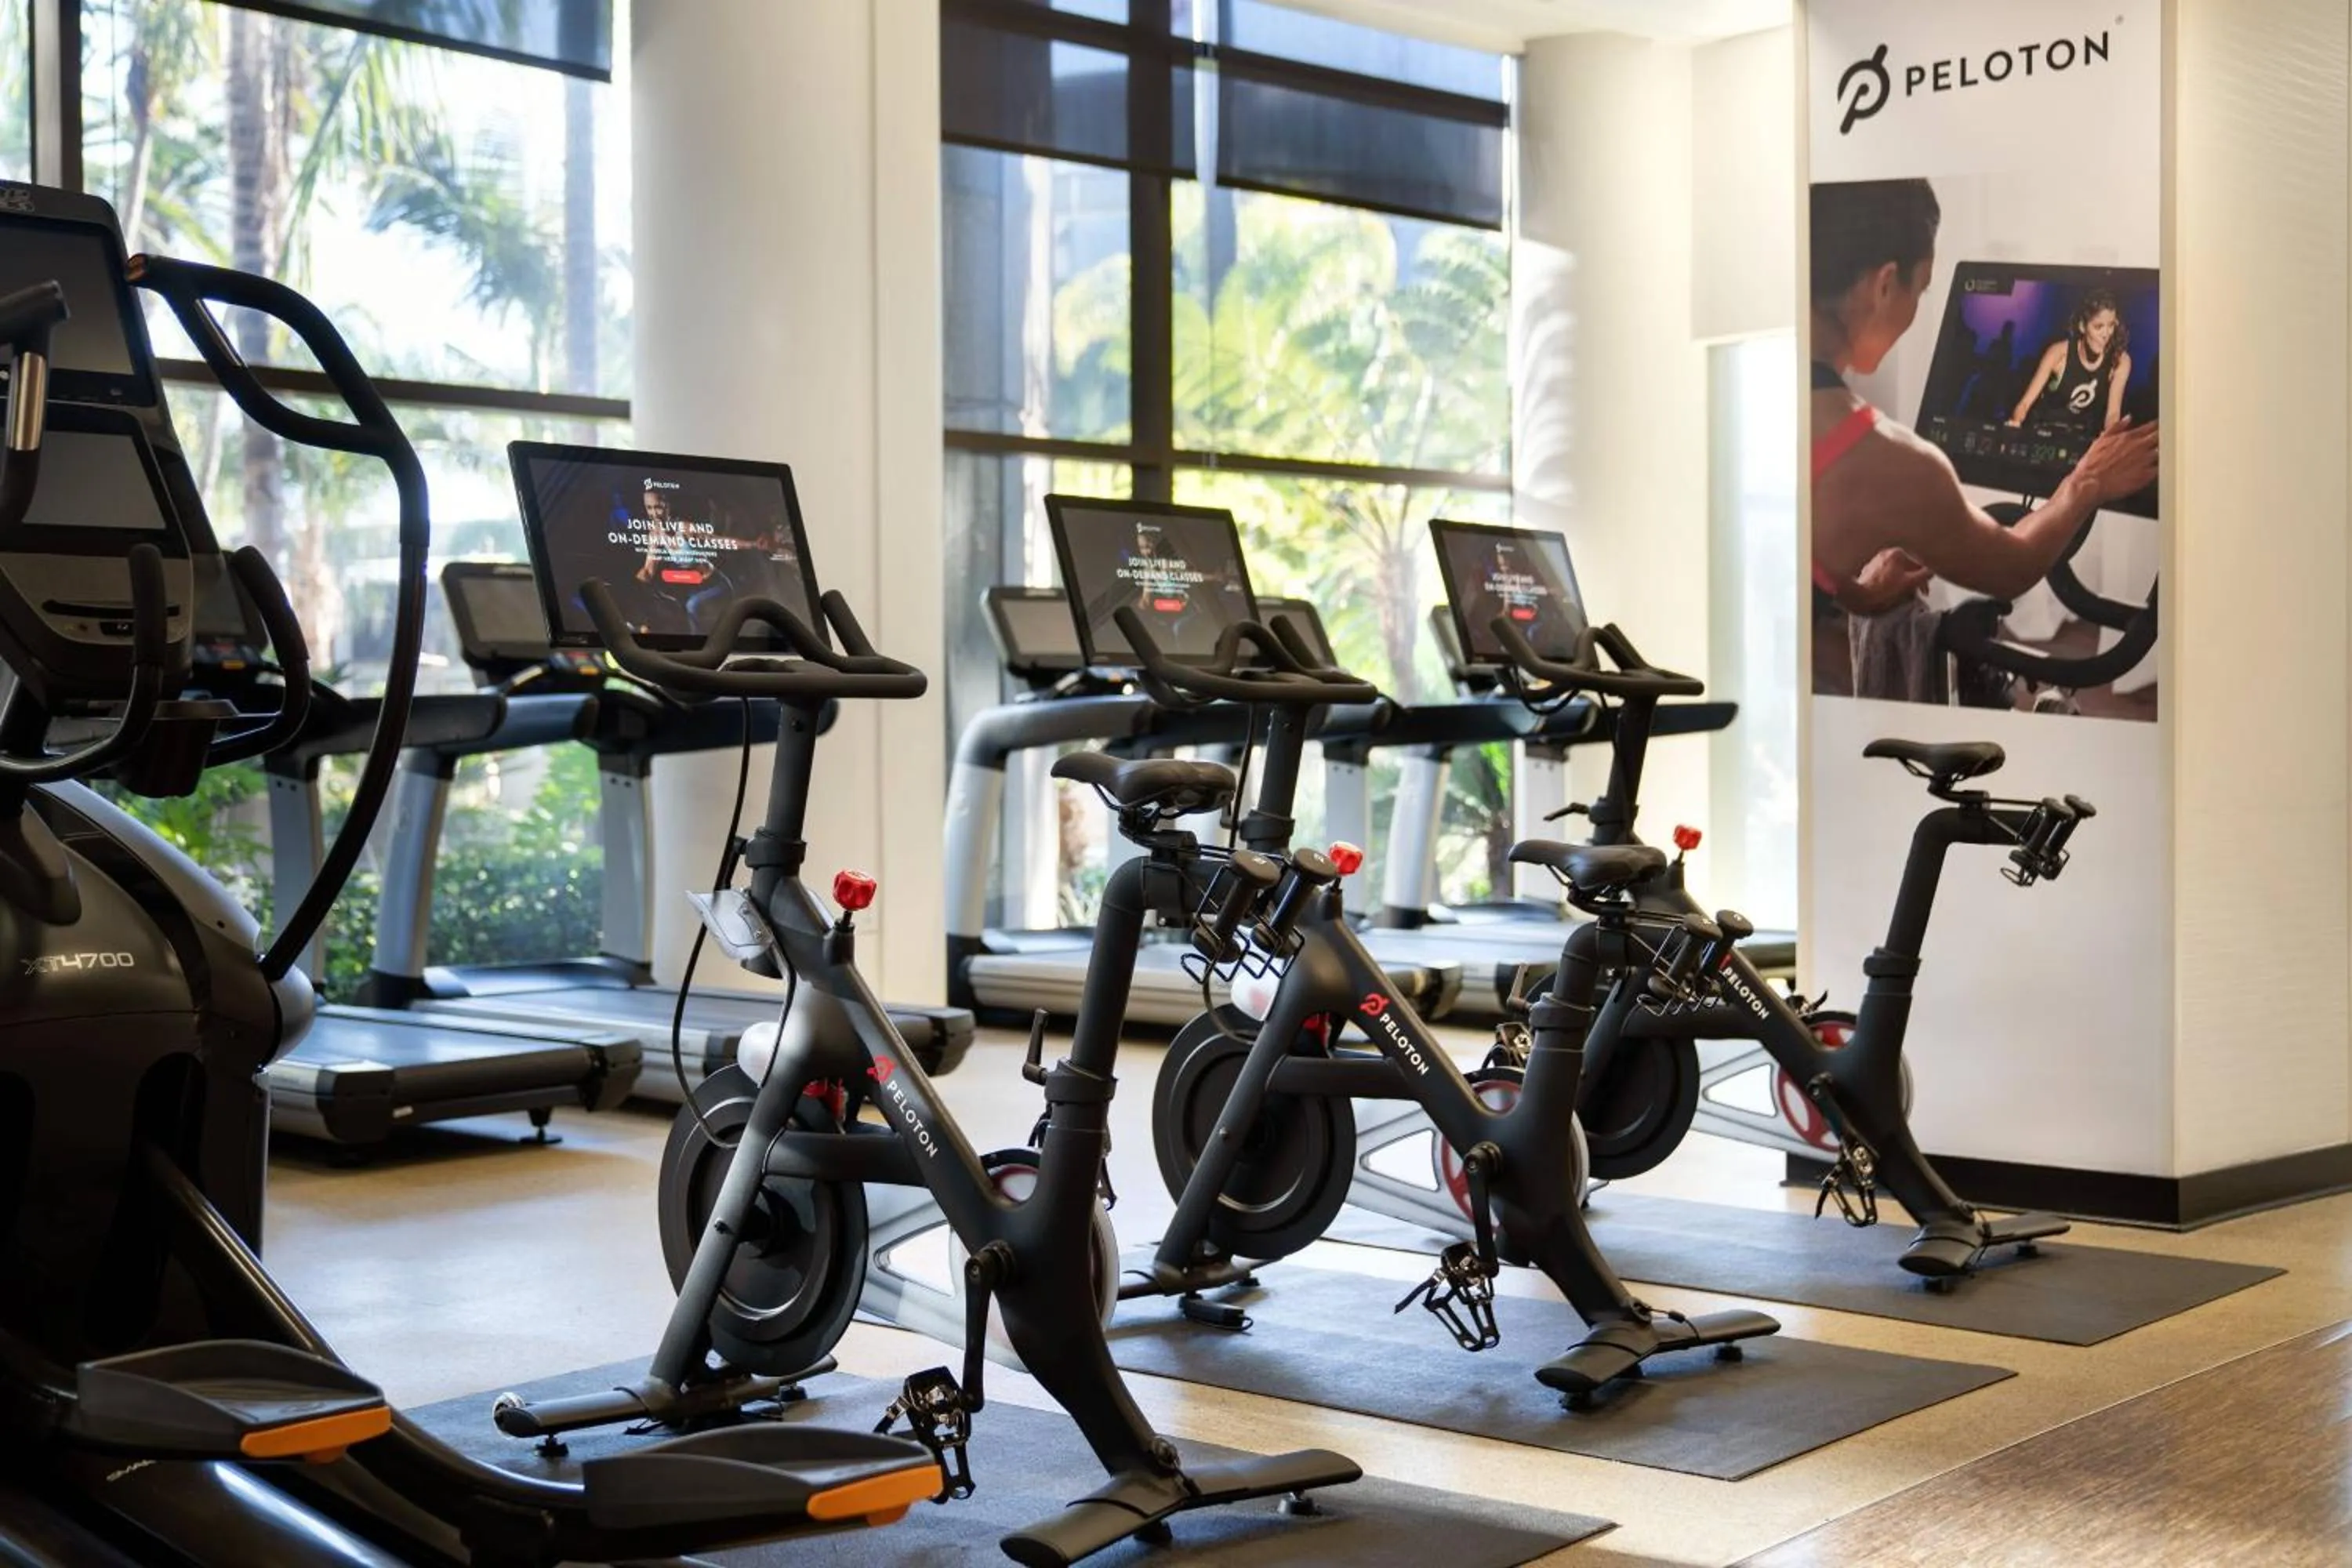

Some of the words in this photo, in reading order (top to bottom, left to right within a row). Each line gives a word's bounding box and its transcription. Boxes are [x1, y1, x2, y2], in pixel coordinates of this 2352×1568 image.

[1906, 31, 2109, 96] PELOTON
[608, 532, 684, 547] ON-DEMAND
[689, 538, 739, 550] CLASSES
[627, 518, 655, 530] JOIN
[660, 521, 684, 532] LIVE
[689, 523, 714, 535] AND
[1128, 557, 1148, 567] JOIN
[1150, 558, 1167, 568] LIVE
[1169, 560, 1186, 569] AND
[1169, 572, 1204, 583] CLASSES
[1721, 967, 1769, 1019] PELOTON
[1379, 1012, 1429, 1076] PELOTON
[886, 1080, 938, 1158] PELOTON
